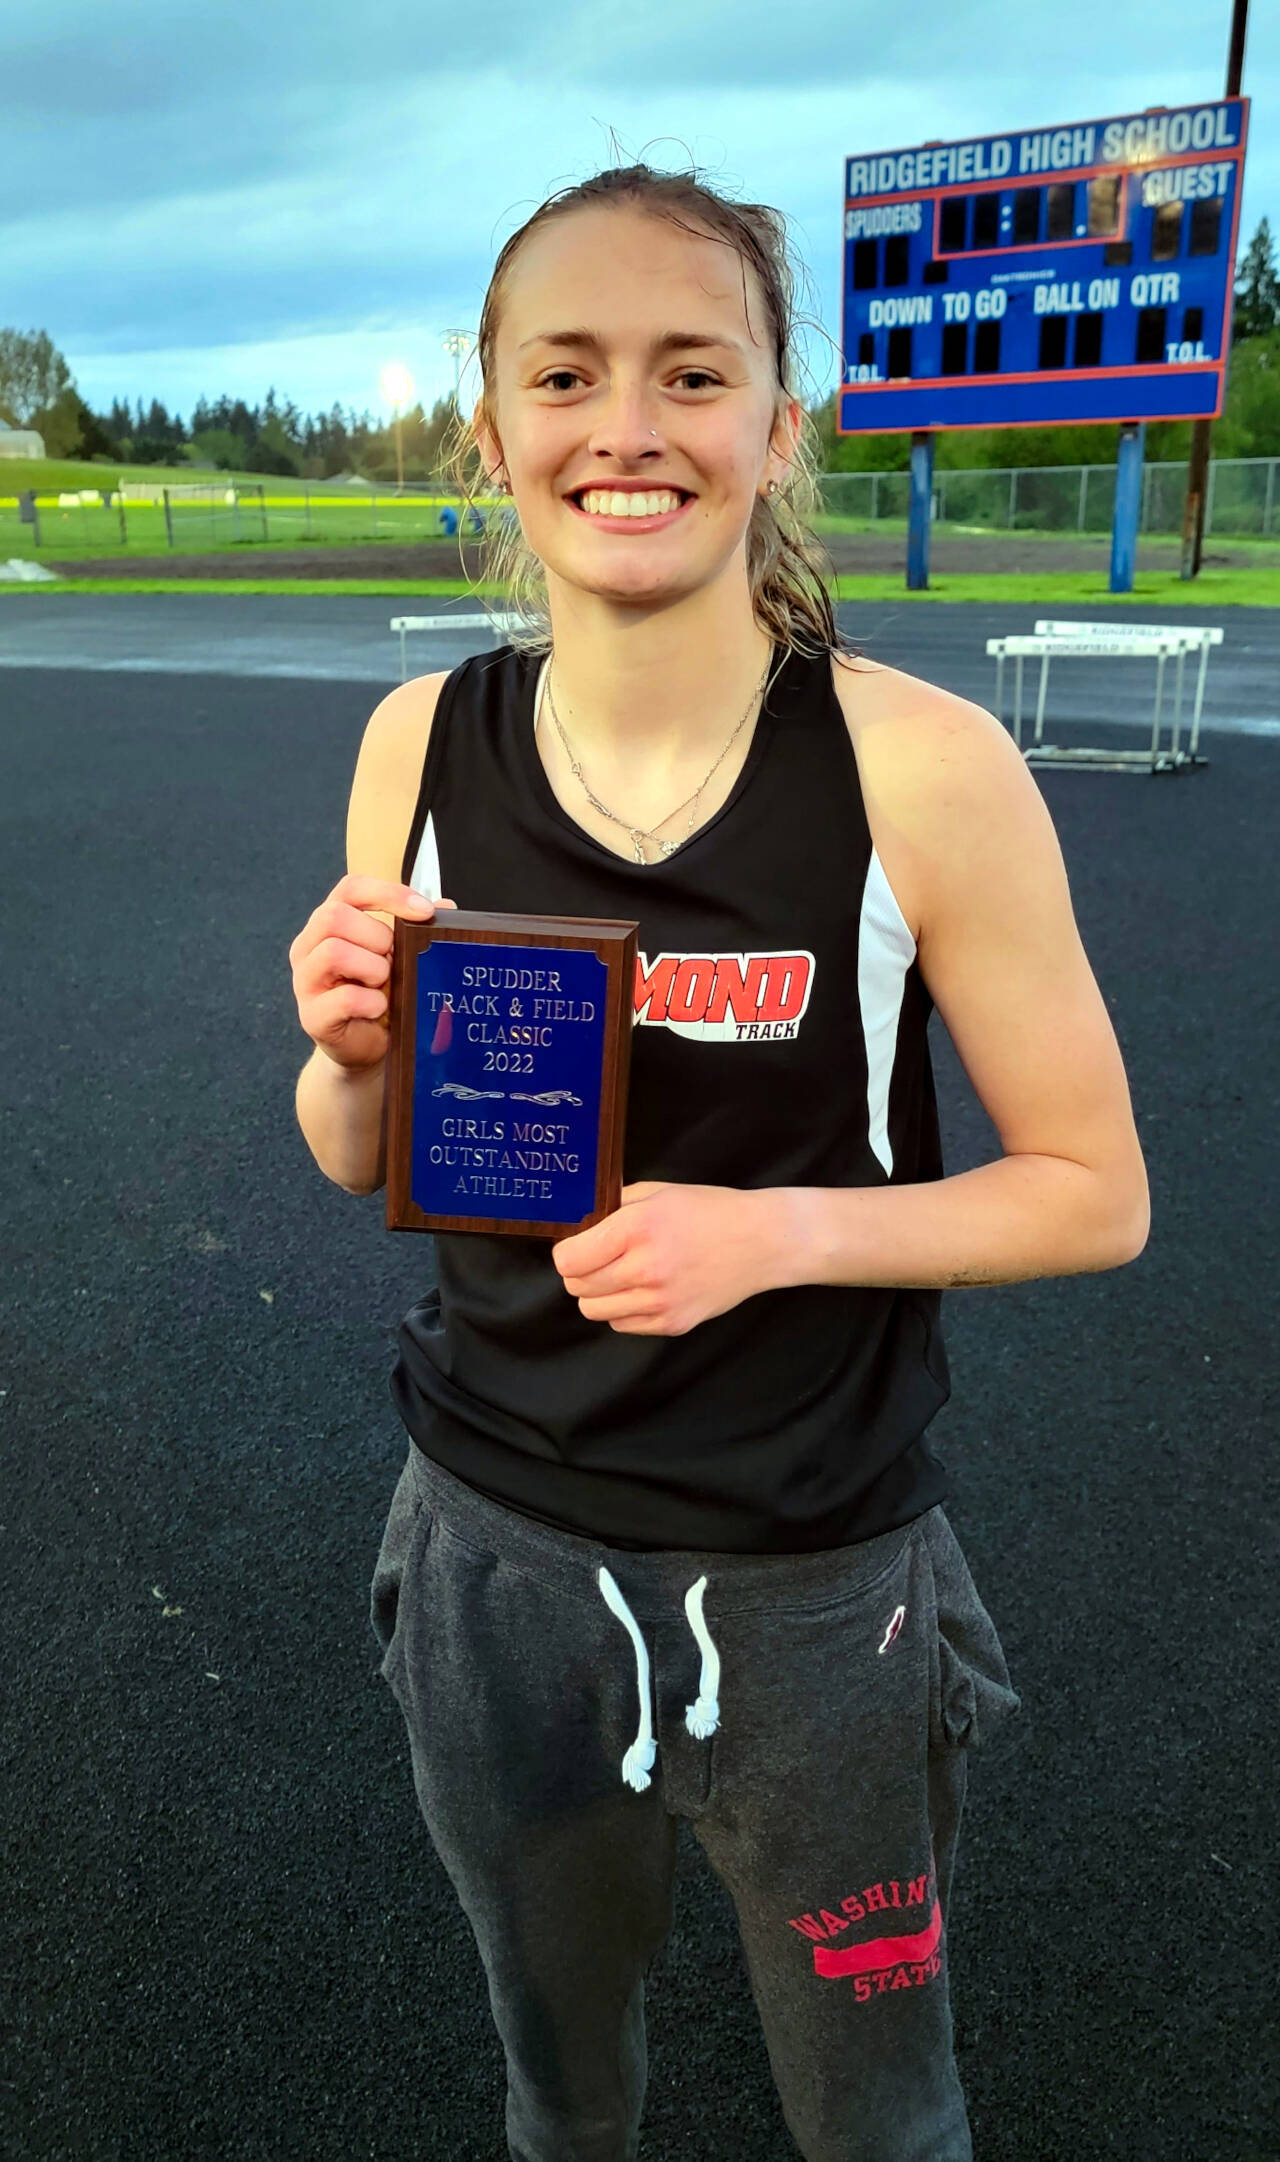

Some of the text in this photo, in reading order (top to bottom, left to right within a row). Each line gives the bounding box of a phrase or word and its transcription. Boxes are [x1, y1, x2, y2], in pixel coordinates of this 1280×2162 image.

[850, 108, 1236, 196] RIDGEFIELD HIGH SCHOOL
[1143, 161, 1234, 207] GUEST
[846, 202, 922, 239] SPUDDERS
[1034, 278, 1119, 314] BALL ON
[1130, 272, 1180, 306] QTR
[869, 288, 1007, 328] DOWN TO GO
[462, 966, 562, 992] SPUDDER
[428, 992, 595, 1022] TRACK & FIELD
[467, 1023, 553, 1047] CLASSIC
[736, 1023, 797, 1040] TRACK
[483, 1052, 535, 1073] 2022
[442, 1118, 569, 1144] GIRLS MOST
[429, 1146, 580, 1172] OUTSTANDING
[453, 1176, 553, 1199] ATHLETE
[788, 1874, 936, 1941] WASHIN
